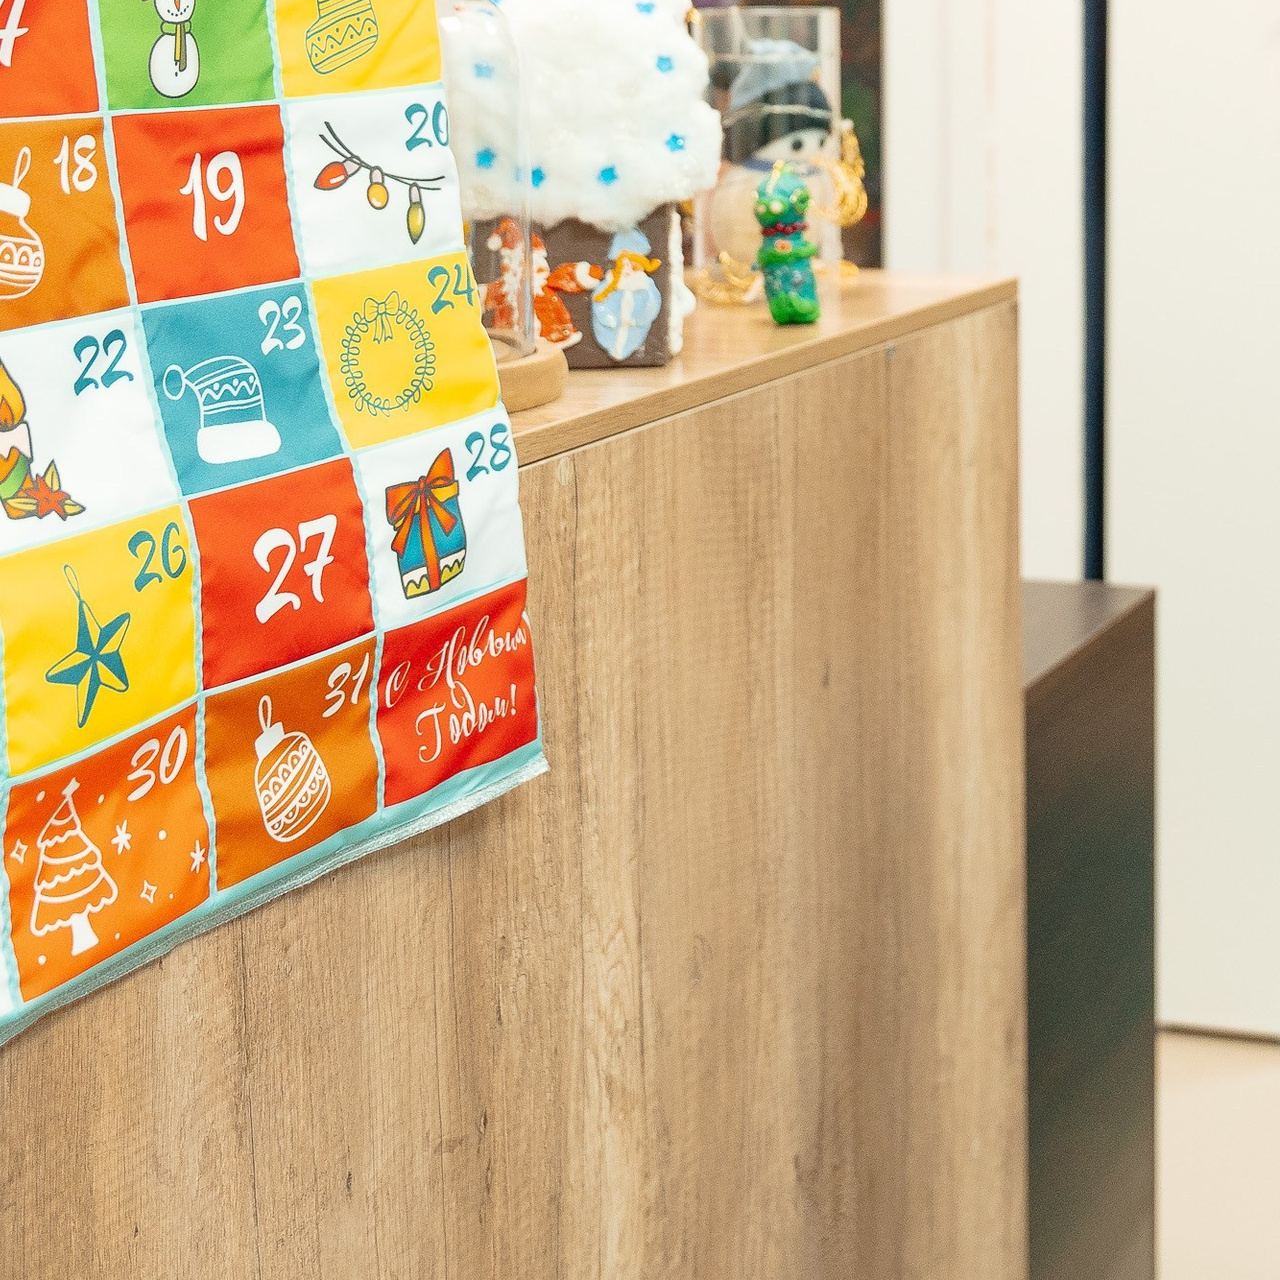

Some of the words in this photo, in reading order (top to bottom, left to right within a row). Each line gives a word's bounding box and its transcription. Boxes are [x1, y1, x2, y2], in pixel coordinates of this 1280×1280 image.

[405, 101, 448, 151] 20
[53, 134, 98, 195] 18
[180, 150, 245, 241] 19
[428, 263, 475, 314] 24
[259, 295, 305, 357] 23
[74, 329, 133, 395] 22
[465, 424, 510, 481] 28
[128, 523, 186, 592] 26
[253, 515, 337, 623] 27
[322, 653, 370, 718] 31
[415, 681, 517, 764] Годом!
[127, 726, 187, 801] 30
